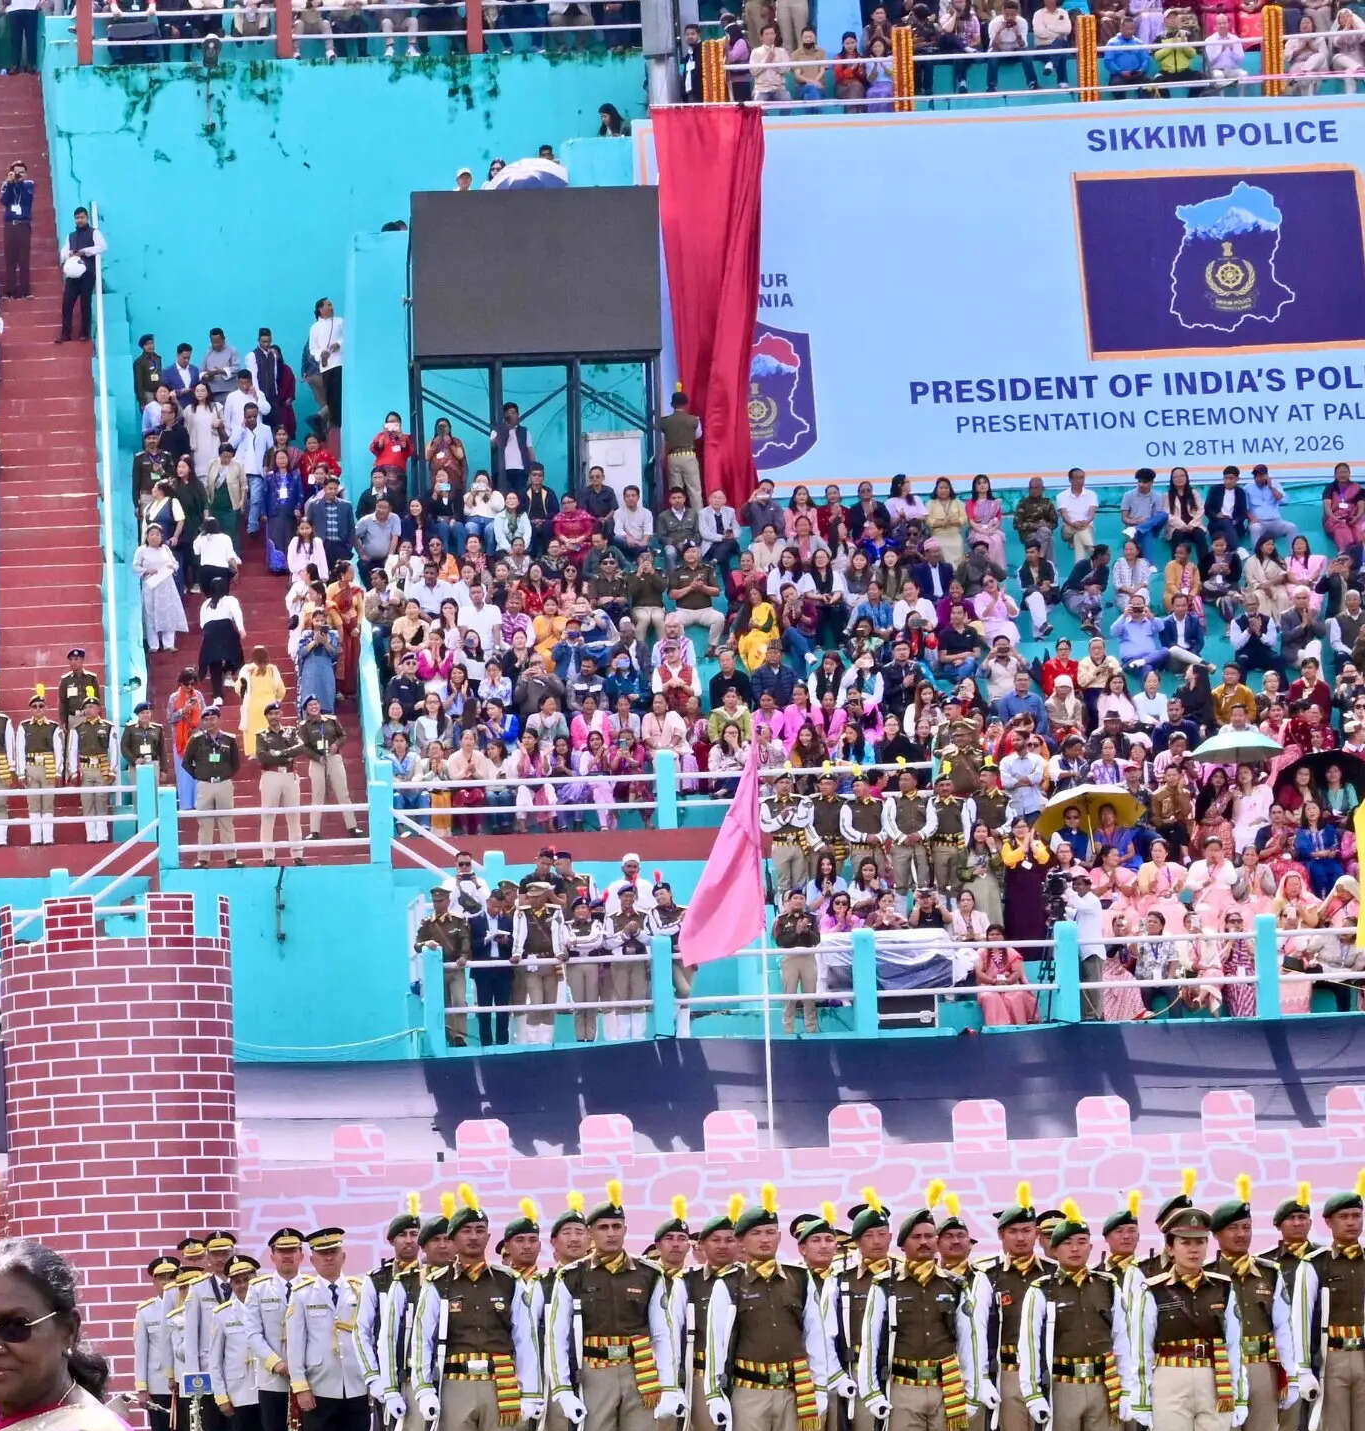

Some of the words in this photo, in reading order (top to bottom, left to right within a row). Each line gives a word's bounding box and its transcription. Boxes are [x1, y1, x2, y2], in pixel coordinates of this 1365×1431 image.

[1086, 124, 1207, 152] SIKKIM
[1216, 119, 1339, 147] POLICE
[761, 273, 788, 288] UR
[909, 375, 1098, 405] PRESIDENT
[1109, 373, 1153, 398] OF
[1163, 367, 1286, 396] INDIA'S
[1295, 365, 1365, 391] POL
[956, 410, 1136, 434] PRESENTATION
[1144, 404, 1280, 427] CEREMONY
[1287, 403, 1315, 422] AT
[1323, 401, 1365, 421] PAL
[1146, 440, 1177, 457] ON
[1183, 438, 1235, 456] 28TH
[1242, 436, 1289, 455] MAY,
[1294, 434, 1345, 452] 2026
